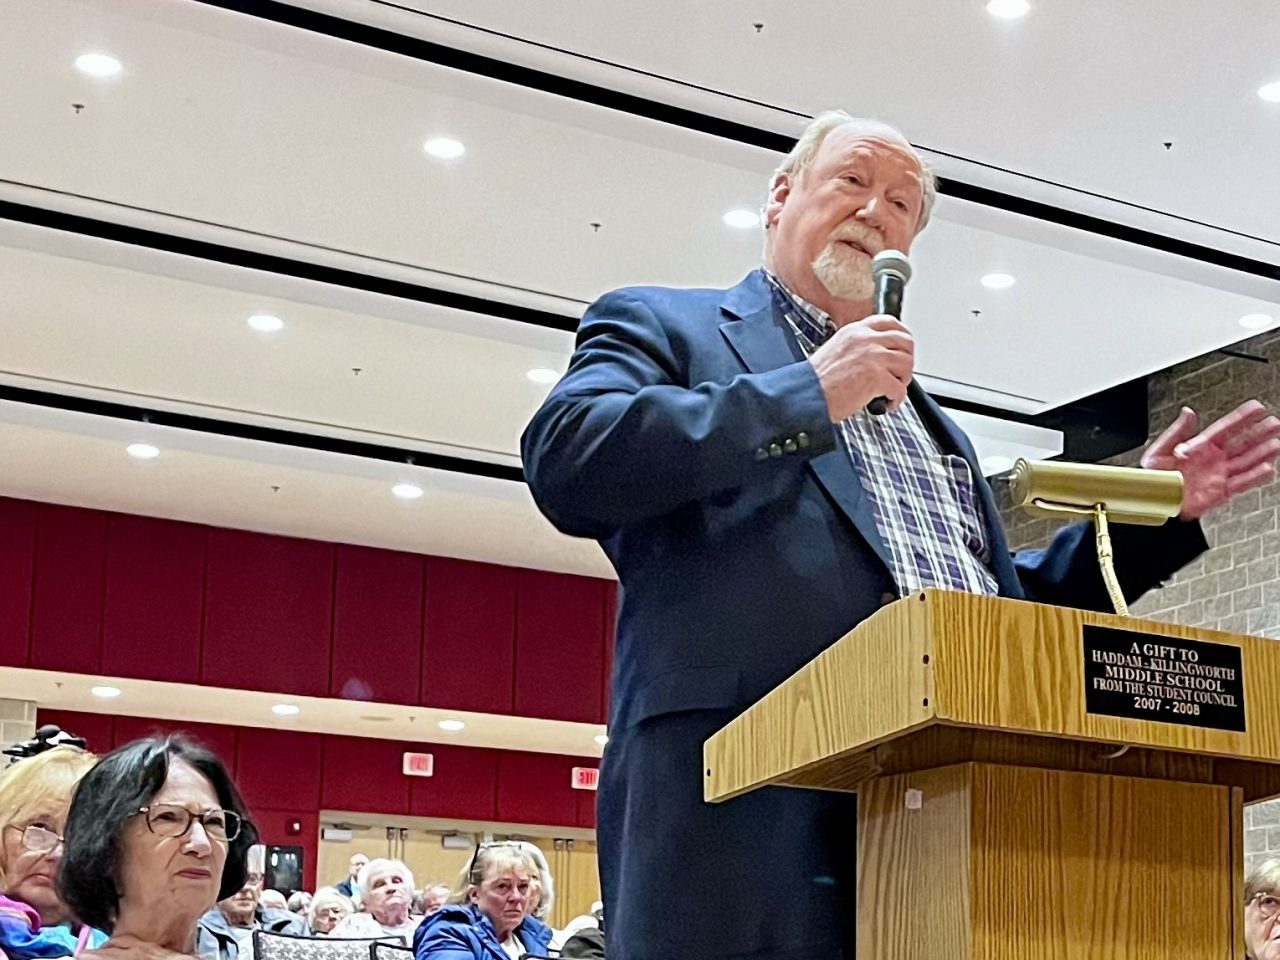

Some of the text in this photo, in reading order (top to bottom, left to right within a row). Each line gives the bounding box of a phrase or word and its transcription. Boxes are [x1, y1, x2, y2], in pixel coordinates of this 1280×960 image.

[1092, 650, 1142, 668] HADDAM
[1150, 658, 1235, 680] KILLINGWORTH
[1130, 642, 1199, 663] A GIFT TO
[1093, 677, 1238, 707] FROM THE STUDENT COUNCIL
[1105, 665, 1226, 693] MIDDLE SCHOOL
[1134, 697, 1161, 711] 2007
[1173, 702, 1200, 716] 2008
